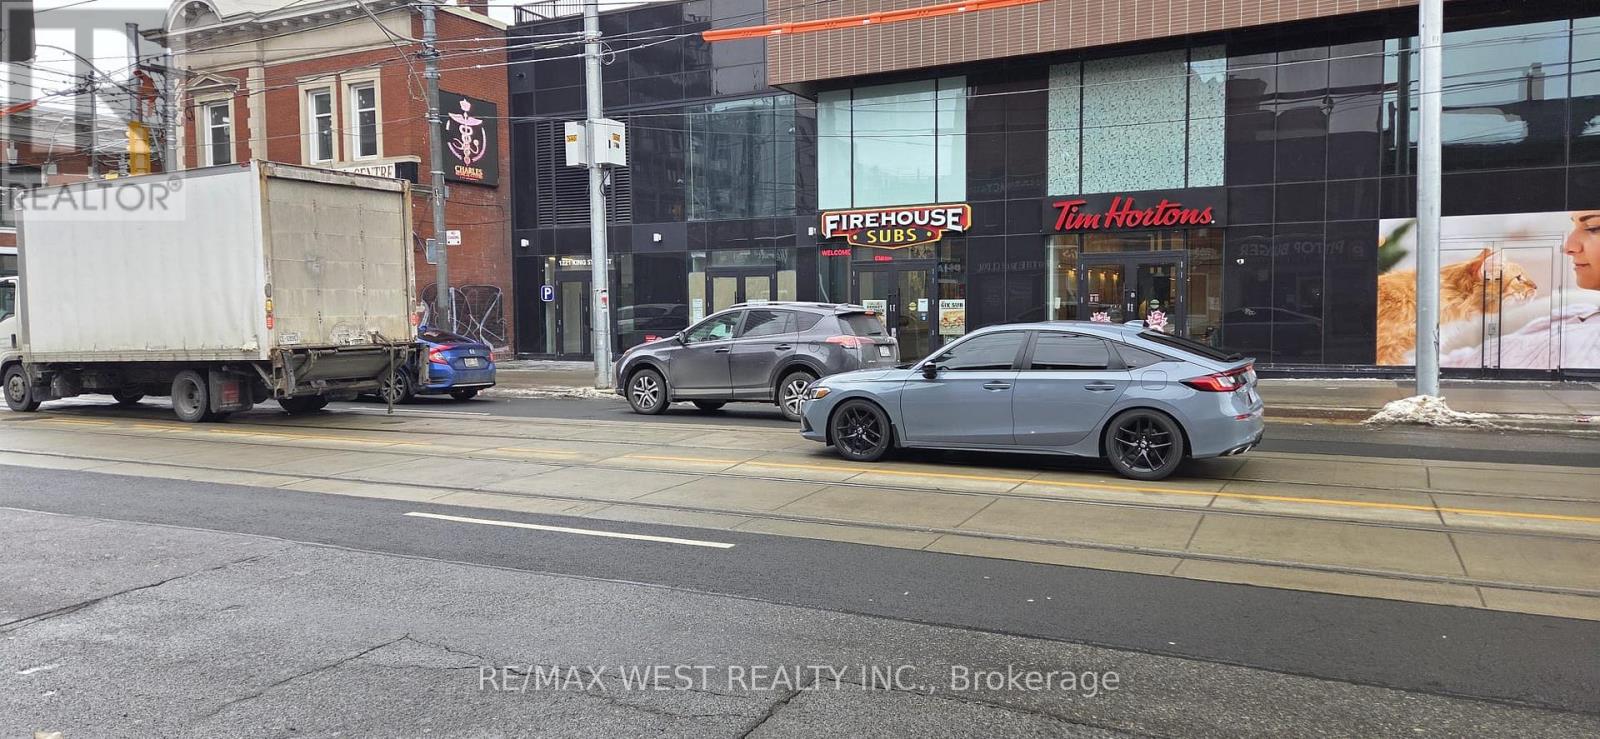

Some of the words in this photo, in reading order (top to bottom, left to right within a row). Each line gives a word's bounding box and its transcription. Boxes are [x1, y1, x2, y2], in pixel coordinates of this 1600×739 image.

[825, 207, 963, 239] FIREHOUSE
[1052, 200, 1102, 231] Tim
[1104, 196, 1213, 228] Hortons
[866, 228, 917, 243] SUBS
[544, 287, 552, 300] P
